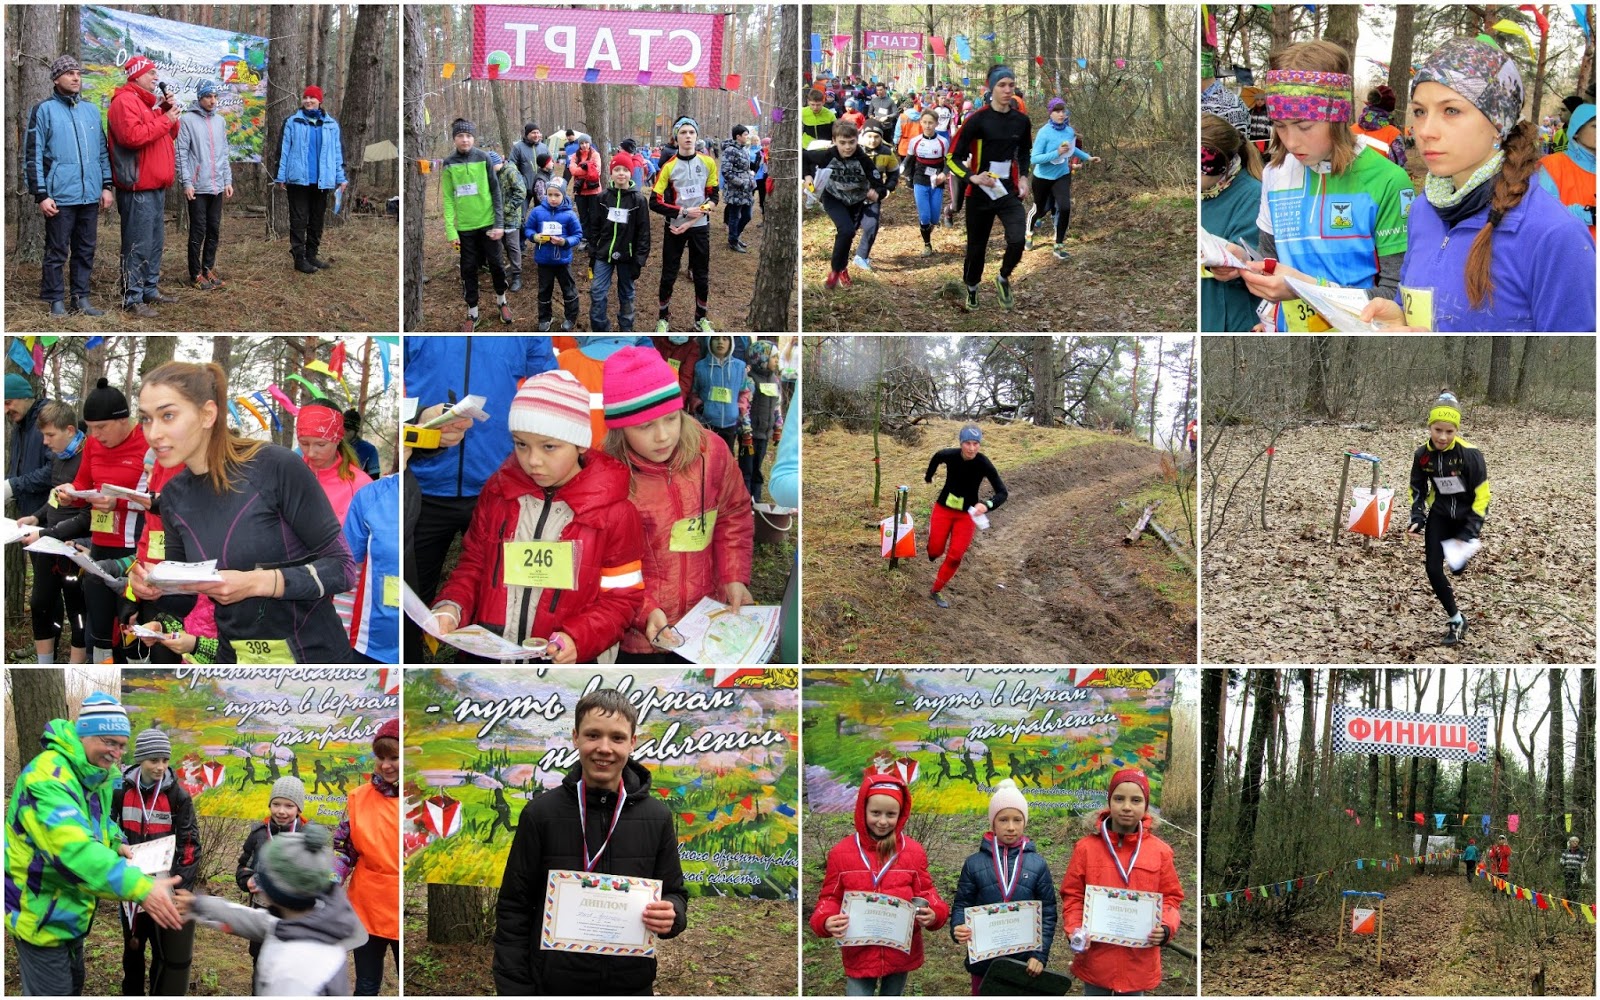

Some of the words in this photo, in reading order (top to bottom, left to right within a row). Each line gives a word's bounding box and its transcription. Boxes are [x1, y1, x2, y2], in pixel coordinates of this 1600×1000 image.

[686, 187, 696, 195] 142
[549, 222, 556, 230] 23
[96, 514, 108, 524] 207
[523, 548, 553, 568] 246
[245, 640, 272, 655] 398
[912, 692, 984, 721] путь
[1008, 679, 1088, 712] верном
[222, 699, 291, 727] путь
[453, 693, 565, 738] путь
[966, 708, 1119, 745] направлении
[1347, 717, 1467, 749] ФИНИШ
[708, 866, 762, 885] области
